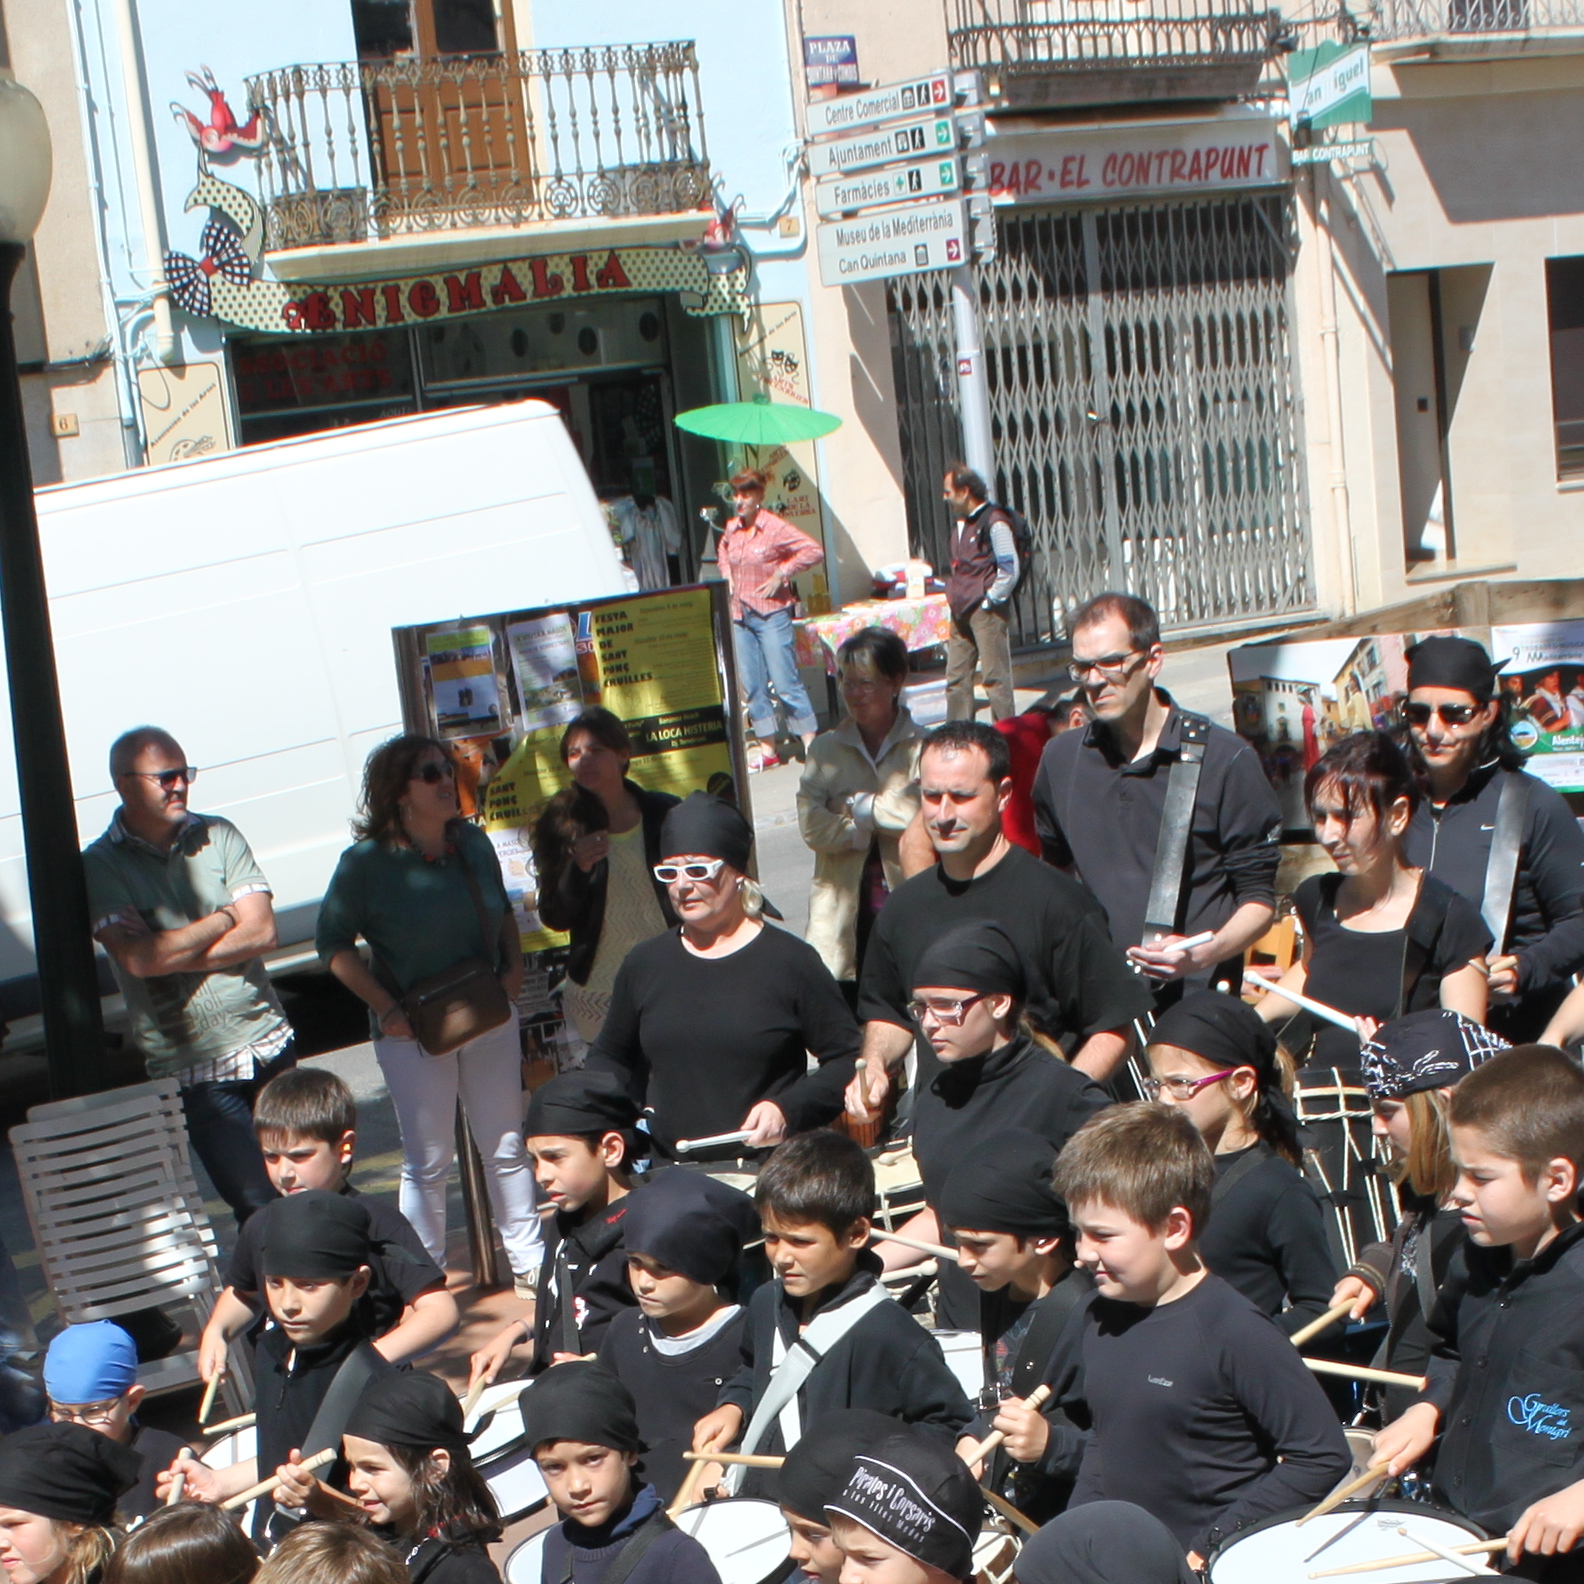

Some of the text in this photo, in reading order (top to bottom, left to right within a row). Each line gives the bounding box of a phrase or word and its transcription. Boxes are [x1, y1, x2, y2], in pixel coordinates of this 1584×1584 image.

[808, 40, 852, 54] PLAZA
[825, 92, 900, 125] Centre Comercial
[829, 136, 894, 169] Ajuntament
[989, 143, 1270, 196] BAR EL CONTRAPUNT
[834, 179, 891, 205] Farmàcies
[785, 220, 792, 231] 7
[836, 209, 953, 248] Museu de la Mediterrània
[839, 250, 907, 274] Can Quintana
[59, 417, 68, 431] 6
[595, 610, 628, 624] FESTA
[599, 639, 613, 650] DE
[601, 650, 628, 663] SANT
[646, 731, 658, 742] LA
[658, 726, 683, 740] LOCA
[683, 720, 723, 736] HISTERIA
[848, 1466, 889, 1501] Pirates
[889, 1487, 936, 1533] Corsaris
